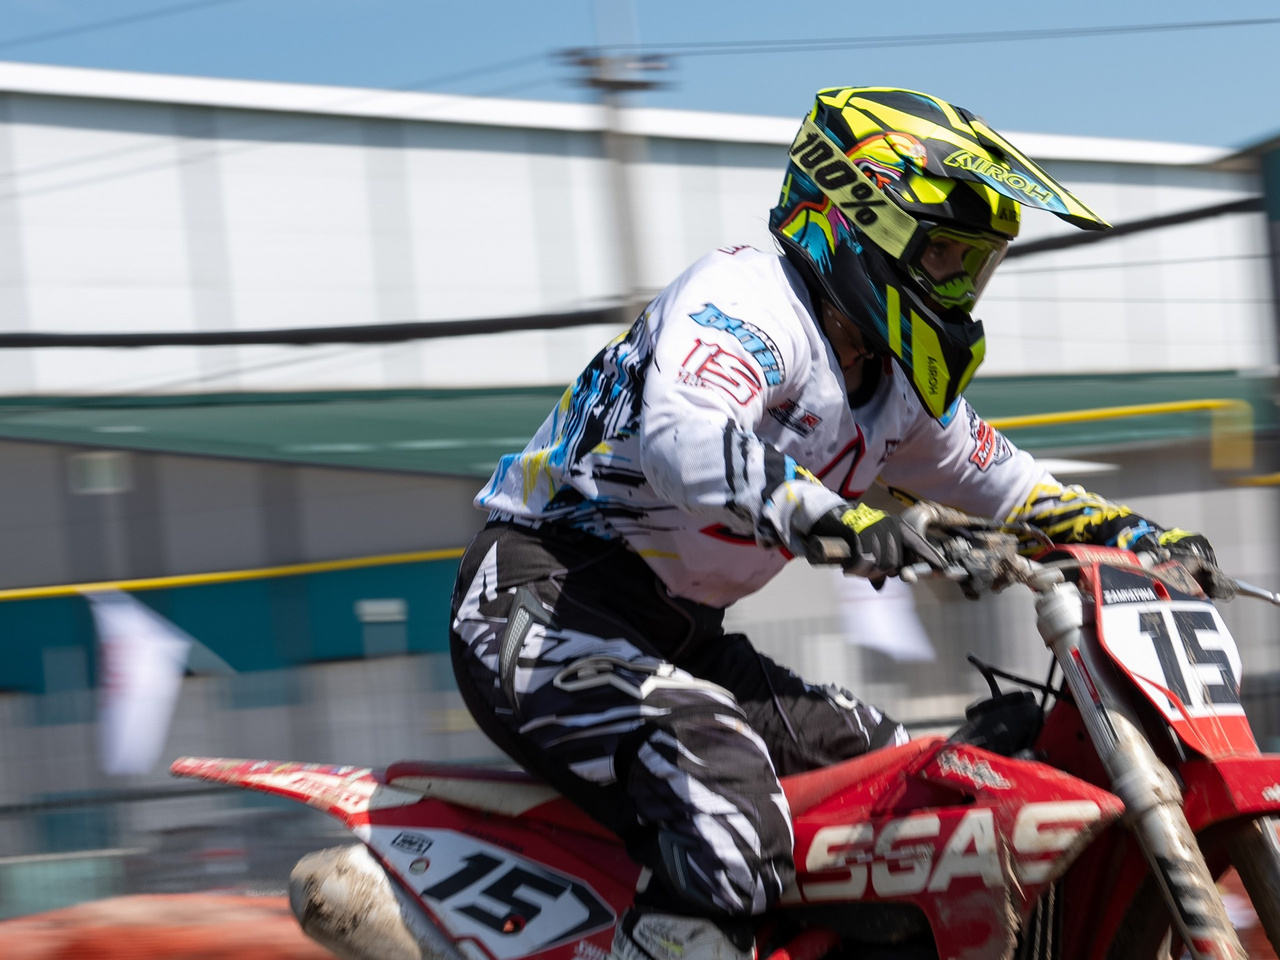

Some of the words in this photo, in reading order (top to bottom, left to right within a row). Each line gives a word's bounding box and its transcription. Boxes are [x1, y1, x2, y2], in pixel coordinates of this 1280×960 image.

[791, 132, 888, 226] 100%
[943, 150, 1054, 204] AIROH
[926, 355, 939, 396] AIROH
[1138, 610, 1240, 711] 15
[420, 851, 573, 936] 15
[784, 799, 1101, 902] SGAS
